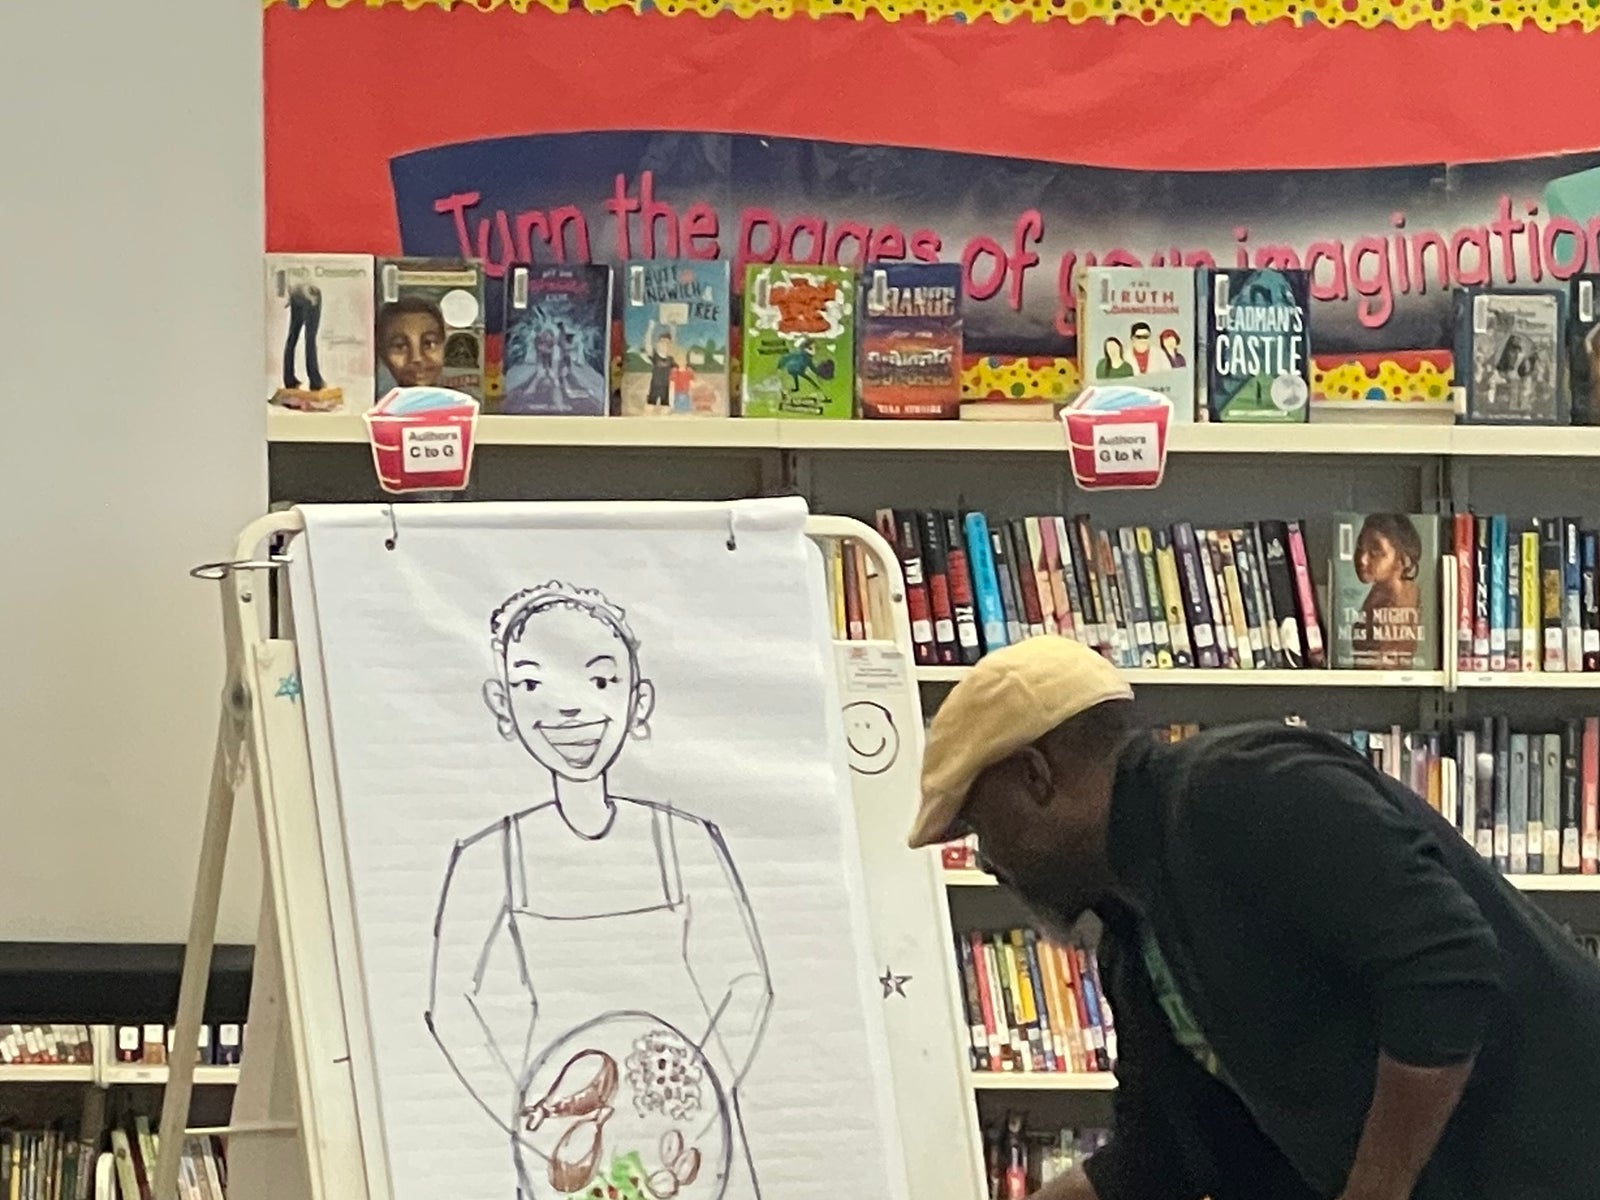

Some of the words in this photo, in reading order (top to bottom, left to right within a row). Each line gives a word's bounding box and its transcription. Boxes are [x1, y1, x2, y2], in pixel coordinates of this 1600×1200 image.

[436, 191, 594, 276] Turn
[607, 171, 719, 260] the
[962, 209, 1046, 309] of
[687, 302, 720, 322] TREE
[1216, 334, 1302, 376] CASTLE
[410, 446, 421, 458] C
[425, 447, 440, 458] to
[1115, 450, 1129, 461] to
[1133, 449, 1143, 461] K
[1343, 606, 1367, 624] The
[1372, 606, 1419, 625] MIGHTY
[1372, 625, 1426, 641] MALONE
